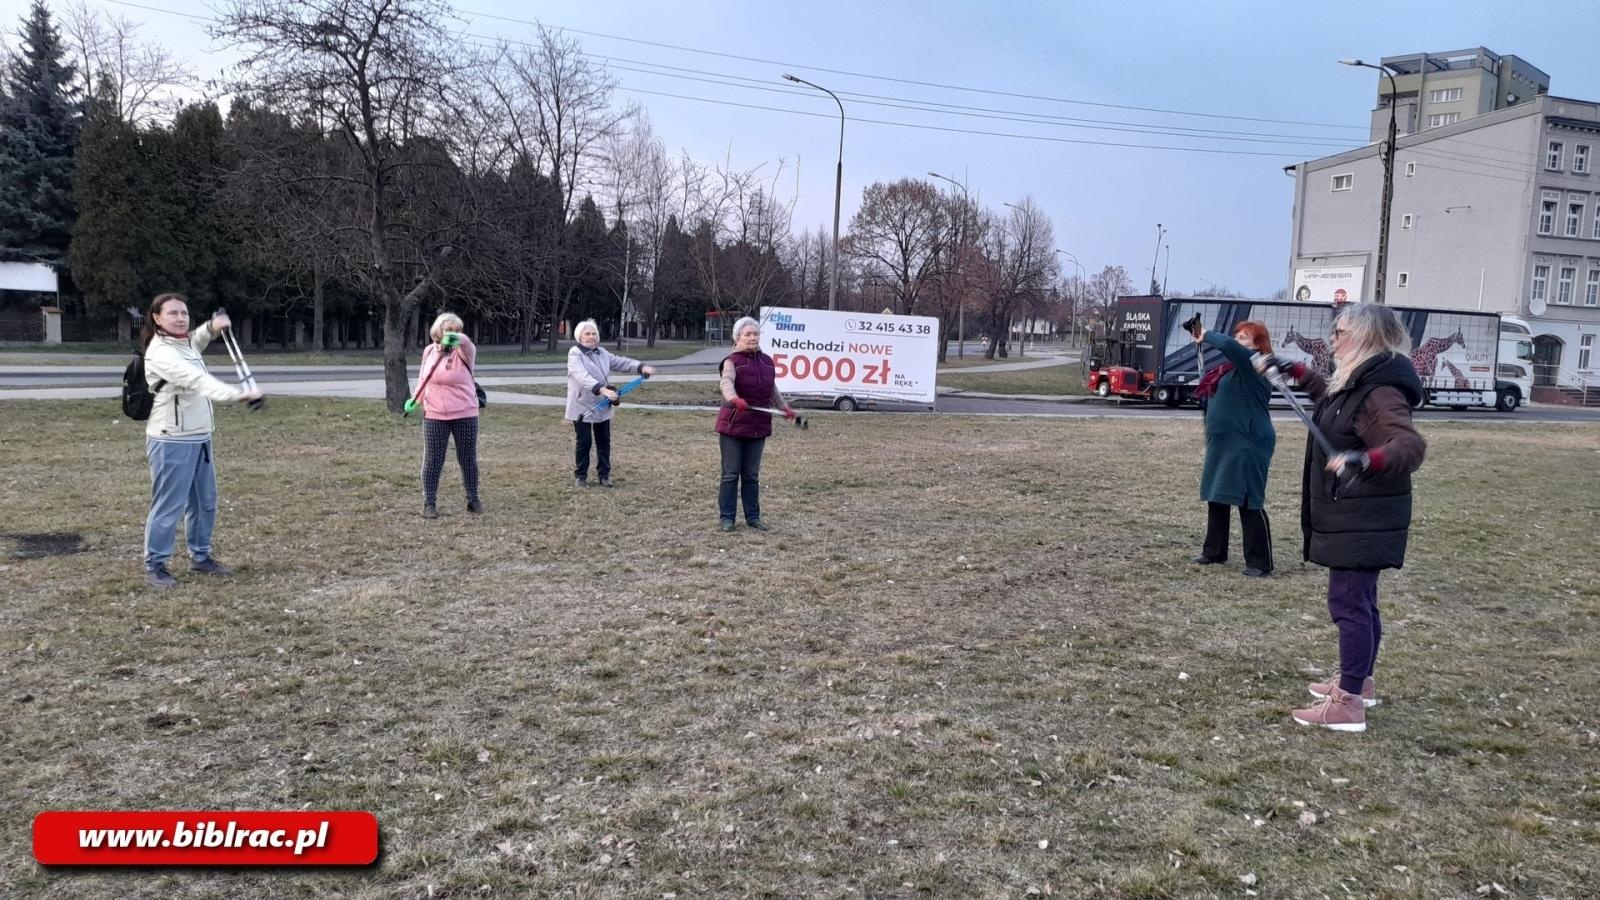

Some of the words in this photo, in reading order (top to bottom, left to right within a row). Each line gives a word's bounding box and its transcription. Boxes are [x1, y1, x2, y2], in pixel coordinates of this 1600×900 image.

[1125, 311, 1151, 322] ŚLĄSKA
[858, 321, 873, 331] 32
[876, 322, 895, 333] 415
[898, 323, 913, 334] 43
[916, 324, 931, 335] 38
[1123, 322, 1152, 331] FABRYKA
[771, 338, 845, 352] Nadchodzi
[848, 342, 893, 356] NOWE
[1465, 353, 1489, 361] QUALITY
[772, 353, 856, 383] 5000
[861, 359, 891, 385] zł
[894, 380, 913, 388] RĘKĘ
